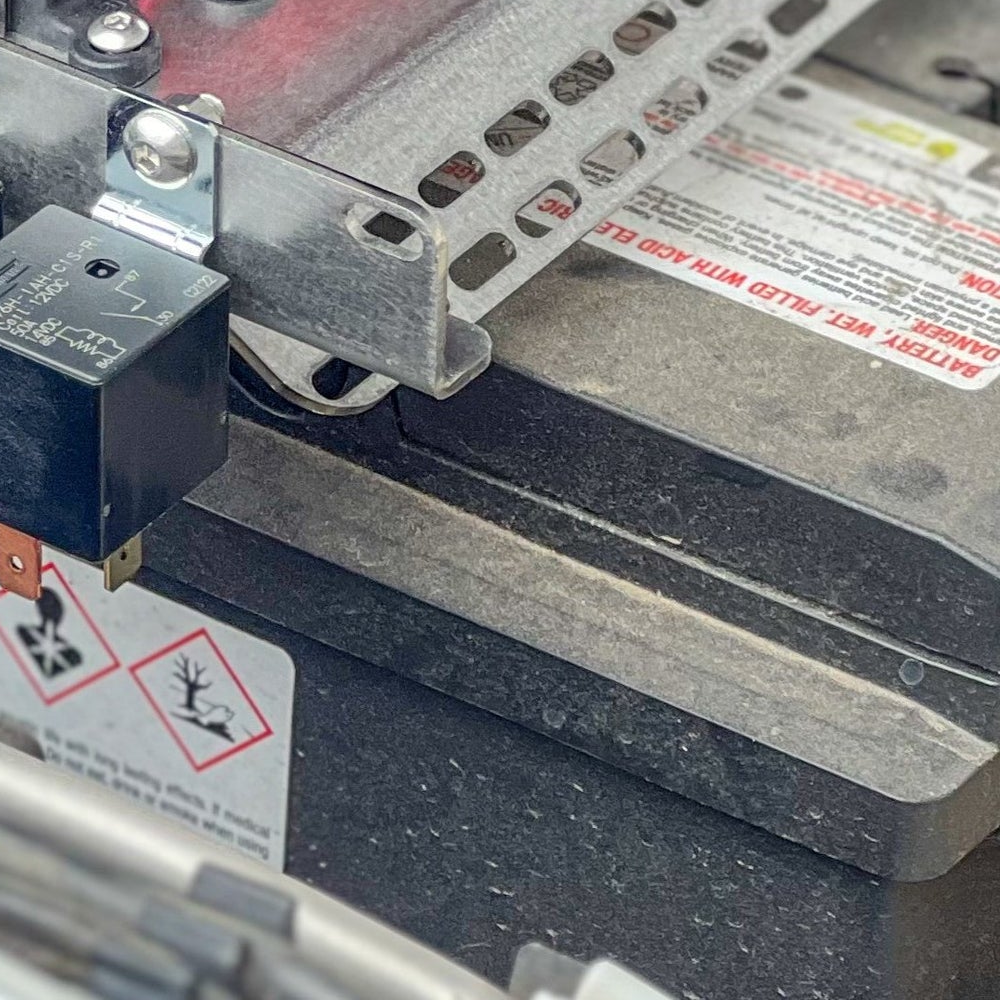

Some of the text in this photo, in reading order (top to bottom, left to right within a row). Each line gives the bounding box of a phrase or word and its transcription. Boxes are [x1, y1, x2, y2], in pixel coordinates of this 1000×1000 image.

[639, 239, 690, 263] ACID
[693, 232, 748, 256] explosive
[772, 243, 796, 257] This
[692, 259, 746, 286] WITH
[749, 254, 804, 277] generate
[782, 257, 810, 272] from
[810, 267, 843, 283] away
[858, 266, 884, 279] and
[801, 274, 853, 298] batteries
[924, 281, 981, 305] physician
[748, 282, 822, 316] FILLED
[851, 294, 881, 308] acid
[879, 305, 912, 321] Lead
[900, 303, 943, 323] lighted
[10, 320, 38, 337] 50A
[25, 317, 62, 342] 14VDC
[942, 319, 969, 332] and
[880, 329, 983, 379] BATTERY,
[224, 810, 270, 839] medical
[202, 820, 234, 840] when
[237, 836, 270, 861] using
